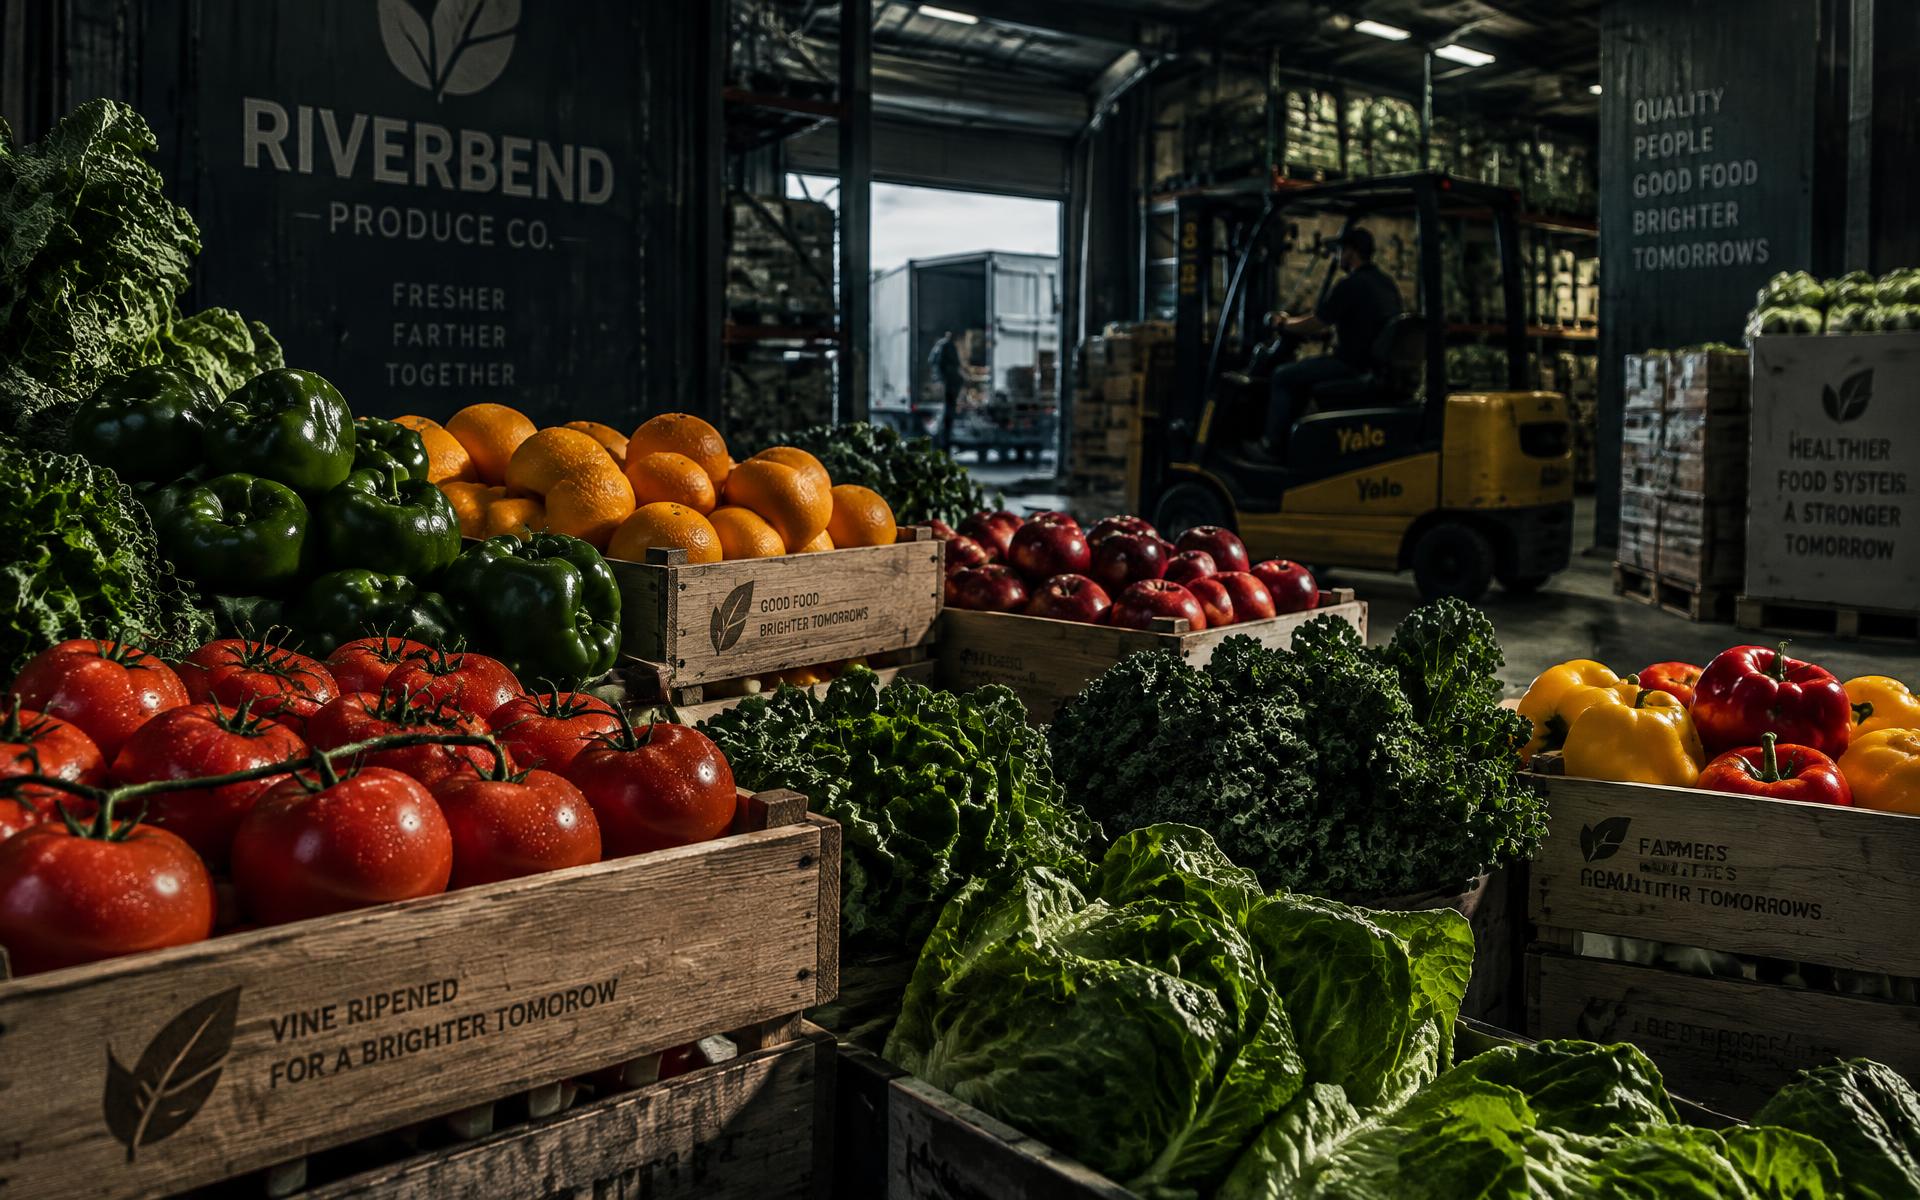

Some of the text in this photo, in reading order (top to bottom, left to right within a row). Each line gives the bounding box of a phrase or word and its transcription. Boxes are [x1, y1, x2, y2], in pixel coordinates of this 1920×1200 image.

[1633, 87, 1725, 126] QUALITY
[242, 97, 615, 204] RIVERBEND
[1633, 126, 1714, 162] PEOPLE
[1632, 159, 1759, 199] GOOD FOOD
[330, 202, 555, 250] PRODUCE CO.
[1632, 201, 1740, 236] BRIGHTER
[1632, 237, 1771, 271] TOMORROWS
[393, 282, 506, 311] FRESHER
[393, 322, 506, 349] FARTHER
[386, 362, 515, 387] TOGETHER
[1789, 437, 1892, 461] HEALTHIER
[1778, 469, 1826, 493] FOOD
[1784, 501, 1902, 526] A STRONGER
[1785, 533, 1896, 560] TOMORROW
[760, 592, 819, 614] GOOD FOOD
[760, 606, 869, 636] BRIGHTER TOMORROWS
[270, 978, 459, 1043] VINE RIPENED
[270, 979, 619, 1089] FOR A BRIGHTER TOMOROW
